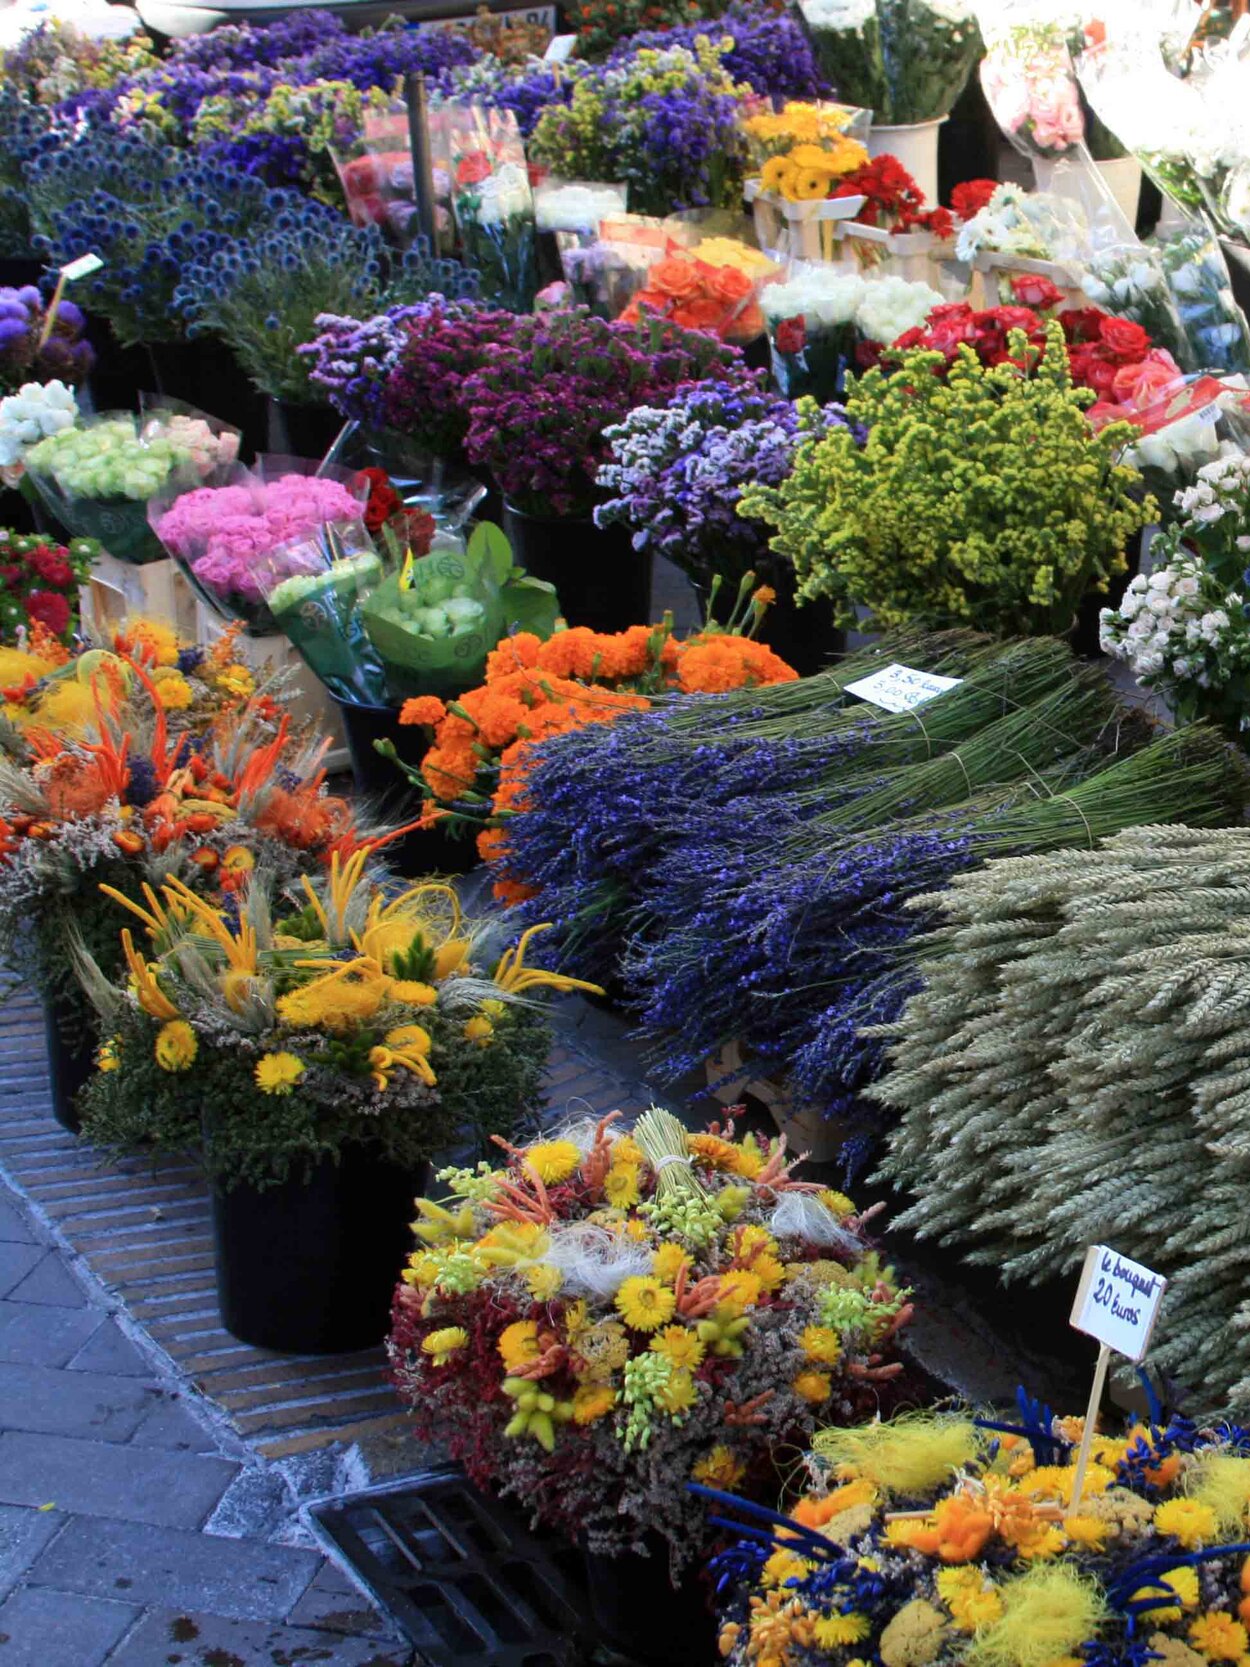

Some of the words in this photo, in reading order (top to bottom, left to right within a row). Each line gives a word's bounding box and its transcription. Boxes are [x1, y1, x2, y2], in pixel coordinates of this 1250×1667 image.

[1093, 1278, 1113, 1306] 20
[1101, 1251, 1112, 1272] le
[1112, 1256, 1161, 1298] bouquet
